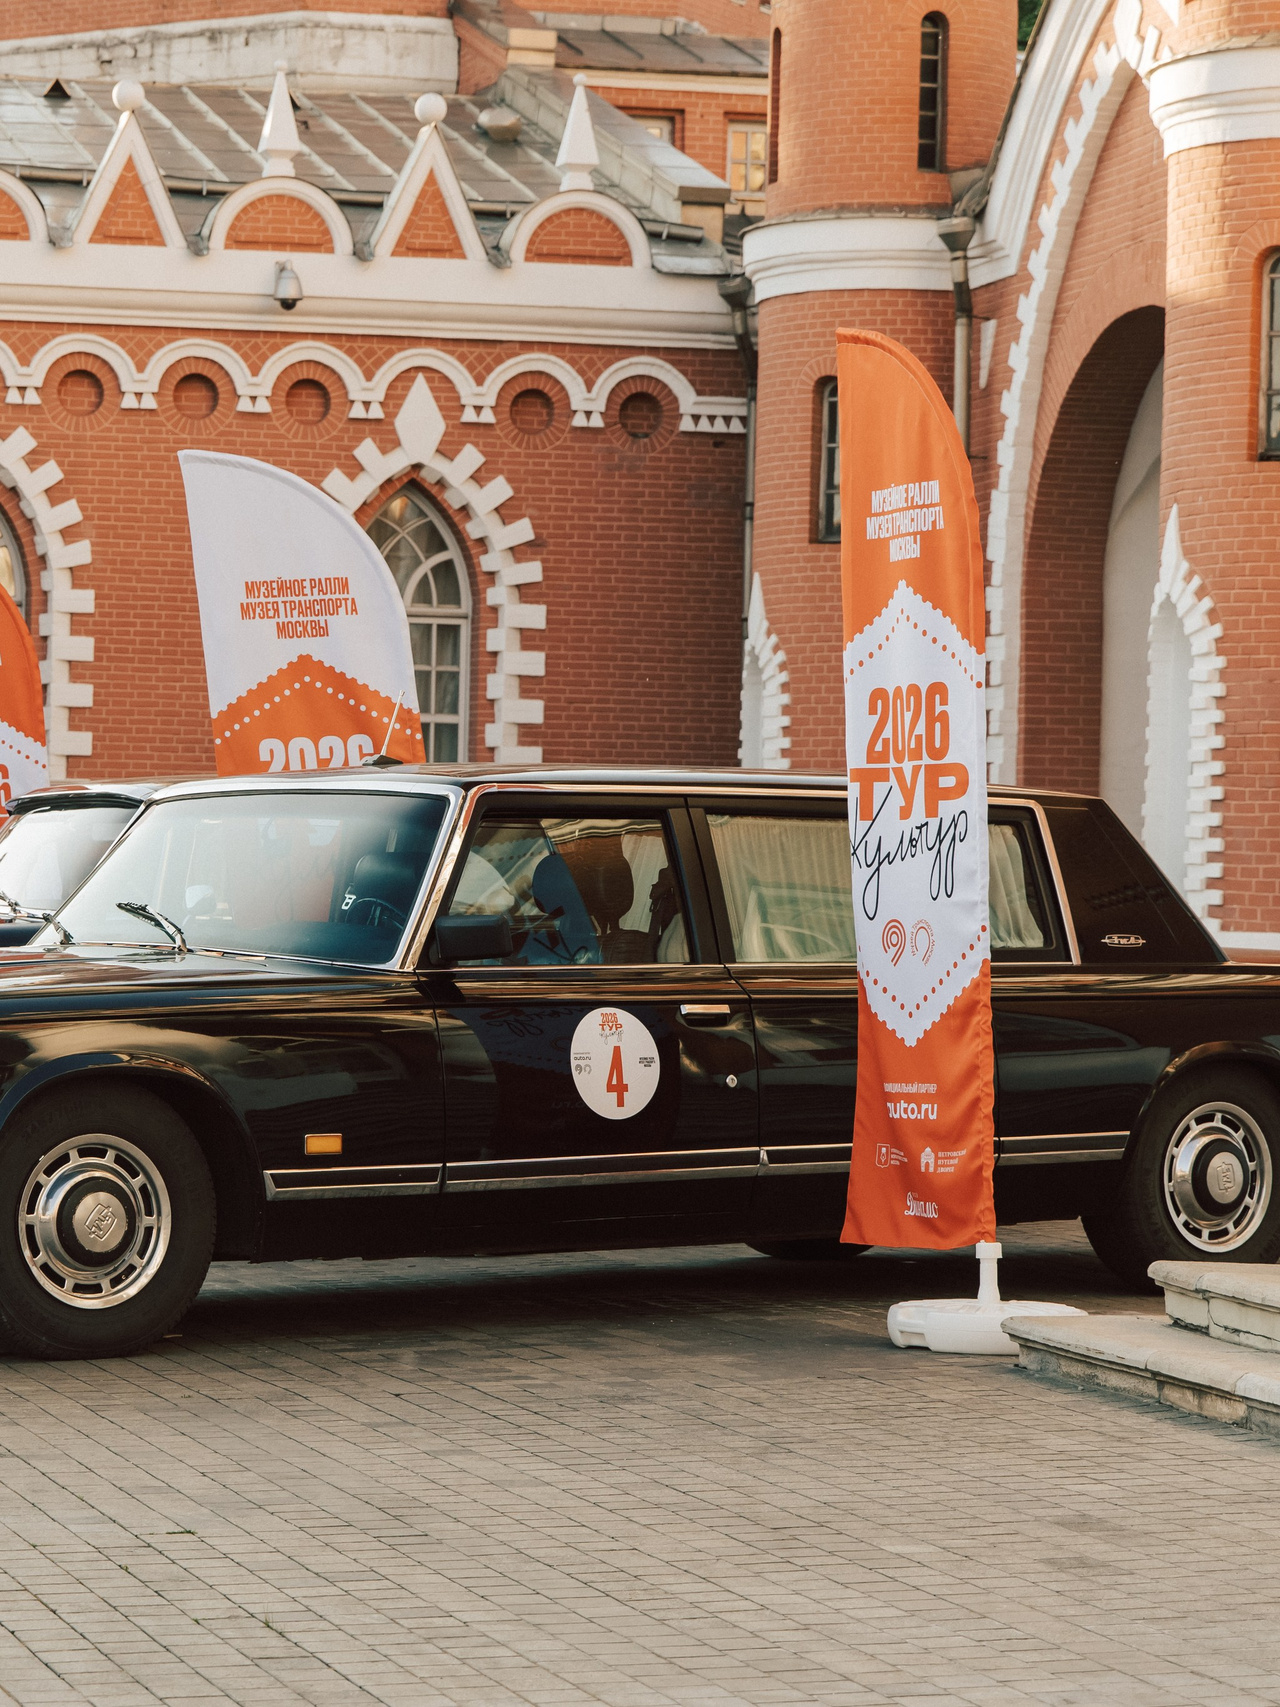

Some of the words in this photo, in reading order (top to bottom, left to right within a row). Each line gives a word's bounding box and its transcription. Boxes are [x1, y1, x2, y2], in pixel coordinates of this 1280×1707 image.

[871, 483, 907, 513] МУЗЕЙНОЕ
[908, 480, 940, 506] РАЛЛИ
[866, 514, 893, 540] МУЗЕЯ
[892, 506, 945, 537] ТРАНСПОРТА
[889, 534, 920, 563] МОСКВЫ
[245, 577, 308, 599] МУЗЕЙНОЕ
[309, 577, 350, 597] РАЛЛИ
[240, 601, 280, 620] МУЗЕЯ
[281, 597, 358, 618] ТРАНСПОРТА
[276, 619, 329, 639] МОСКВЫ
[866, 682, 950, 765] 2026
[850, 763, 970, 822] ТУР
[850, 785, 969, 921] Культур
[599, 1023, 623, 1031] ТУР
[606, 1045, 629, 1108] 4
